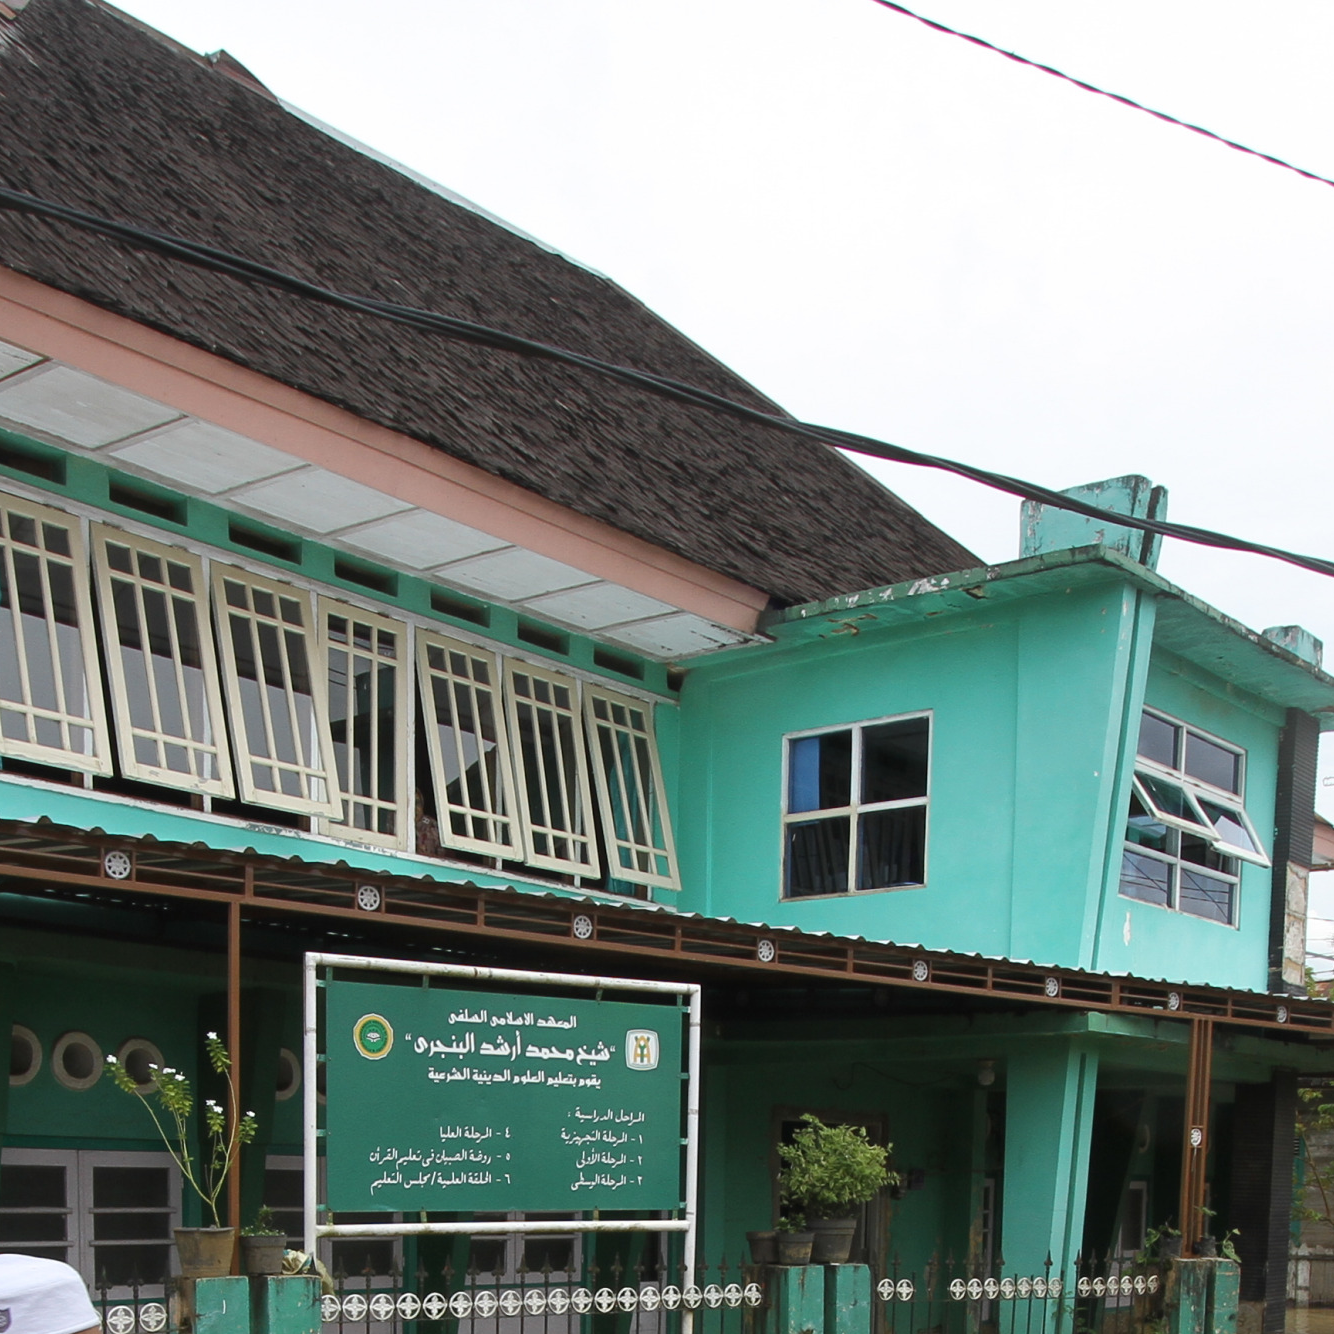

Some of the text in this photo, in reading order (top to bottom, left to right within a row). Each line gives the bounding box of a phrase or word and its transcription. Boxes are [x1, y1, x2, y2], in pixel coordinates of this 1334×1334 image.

[536, 1015, 577, 1030] المعهد
[479, 1029, 522, 1062] أرشد
[525, 1044, 575, 1061] محمد
[427, 1067, 602, 1090] يقوم بتعليم العلوم الدينية الشرعية
[574, 1106, 614, 1123] الدراسية
[614, 1109, 645, 1127] المراحل
[439, 1125, 462, 1143] العليا
[463, 1125, 492, 1144] المرحلة
[602, 1130, 628, 1147] المرحلة
[393, 1147, 424, 1171] تعليم
[468, 1149, 492, 1165] روضة
[575, 1147, 601, 1169] الأولى
[600, 1151, 627, 1169] المرحلة
[370, 1170, 403, 1196] التعليم
[467, 1171, 492, 1185] الحلقة
[570, 1171, 601, 1191] الوسطى
[598, 1173, 627, 1190] المرحلة
